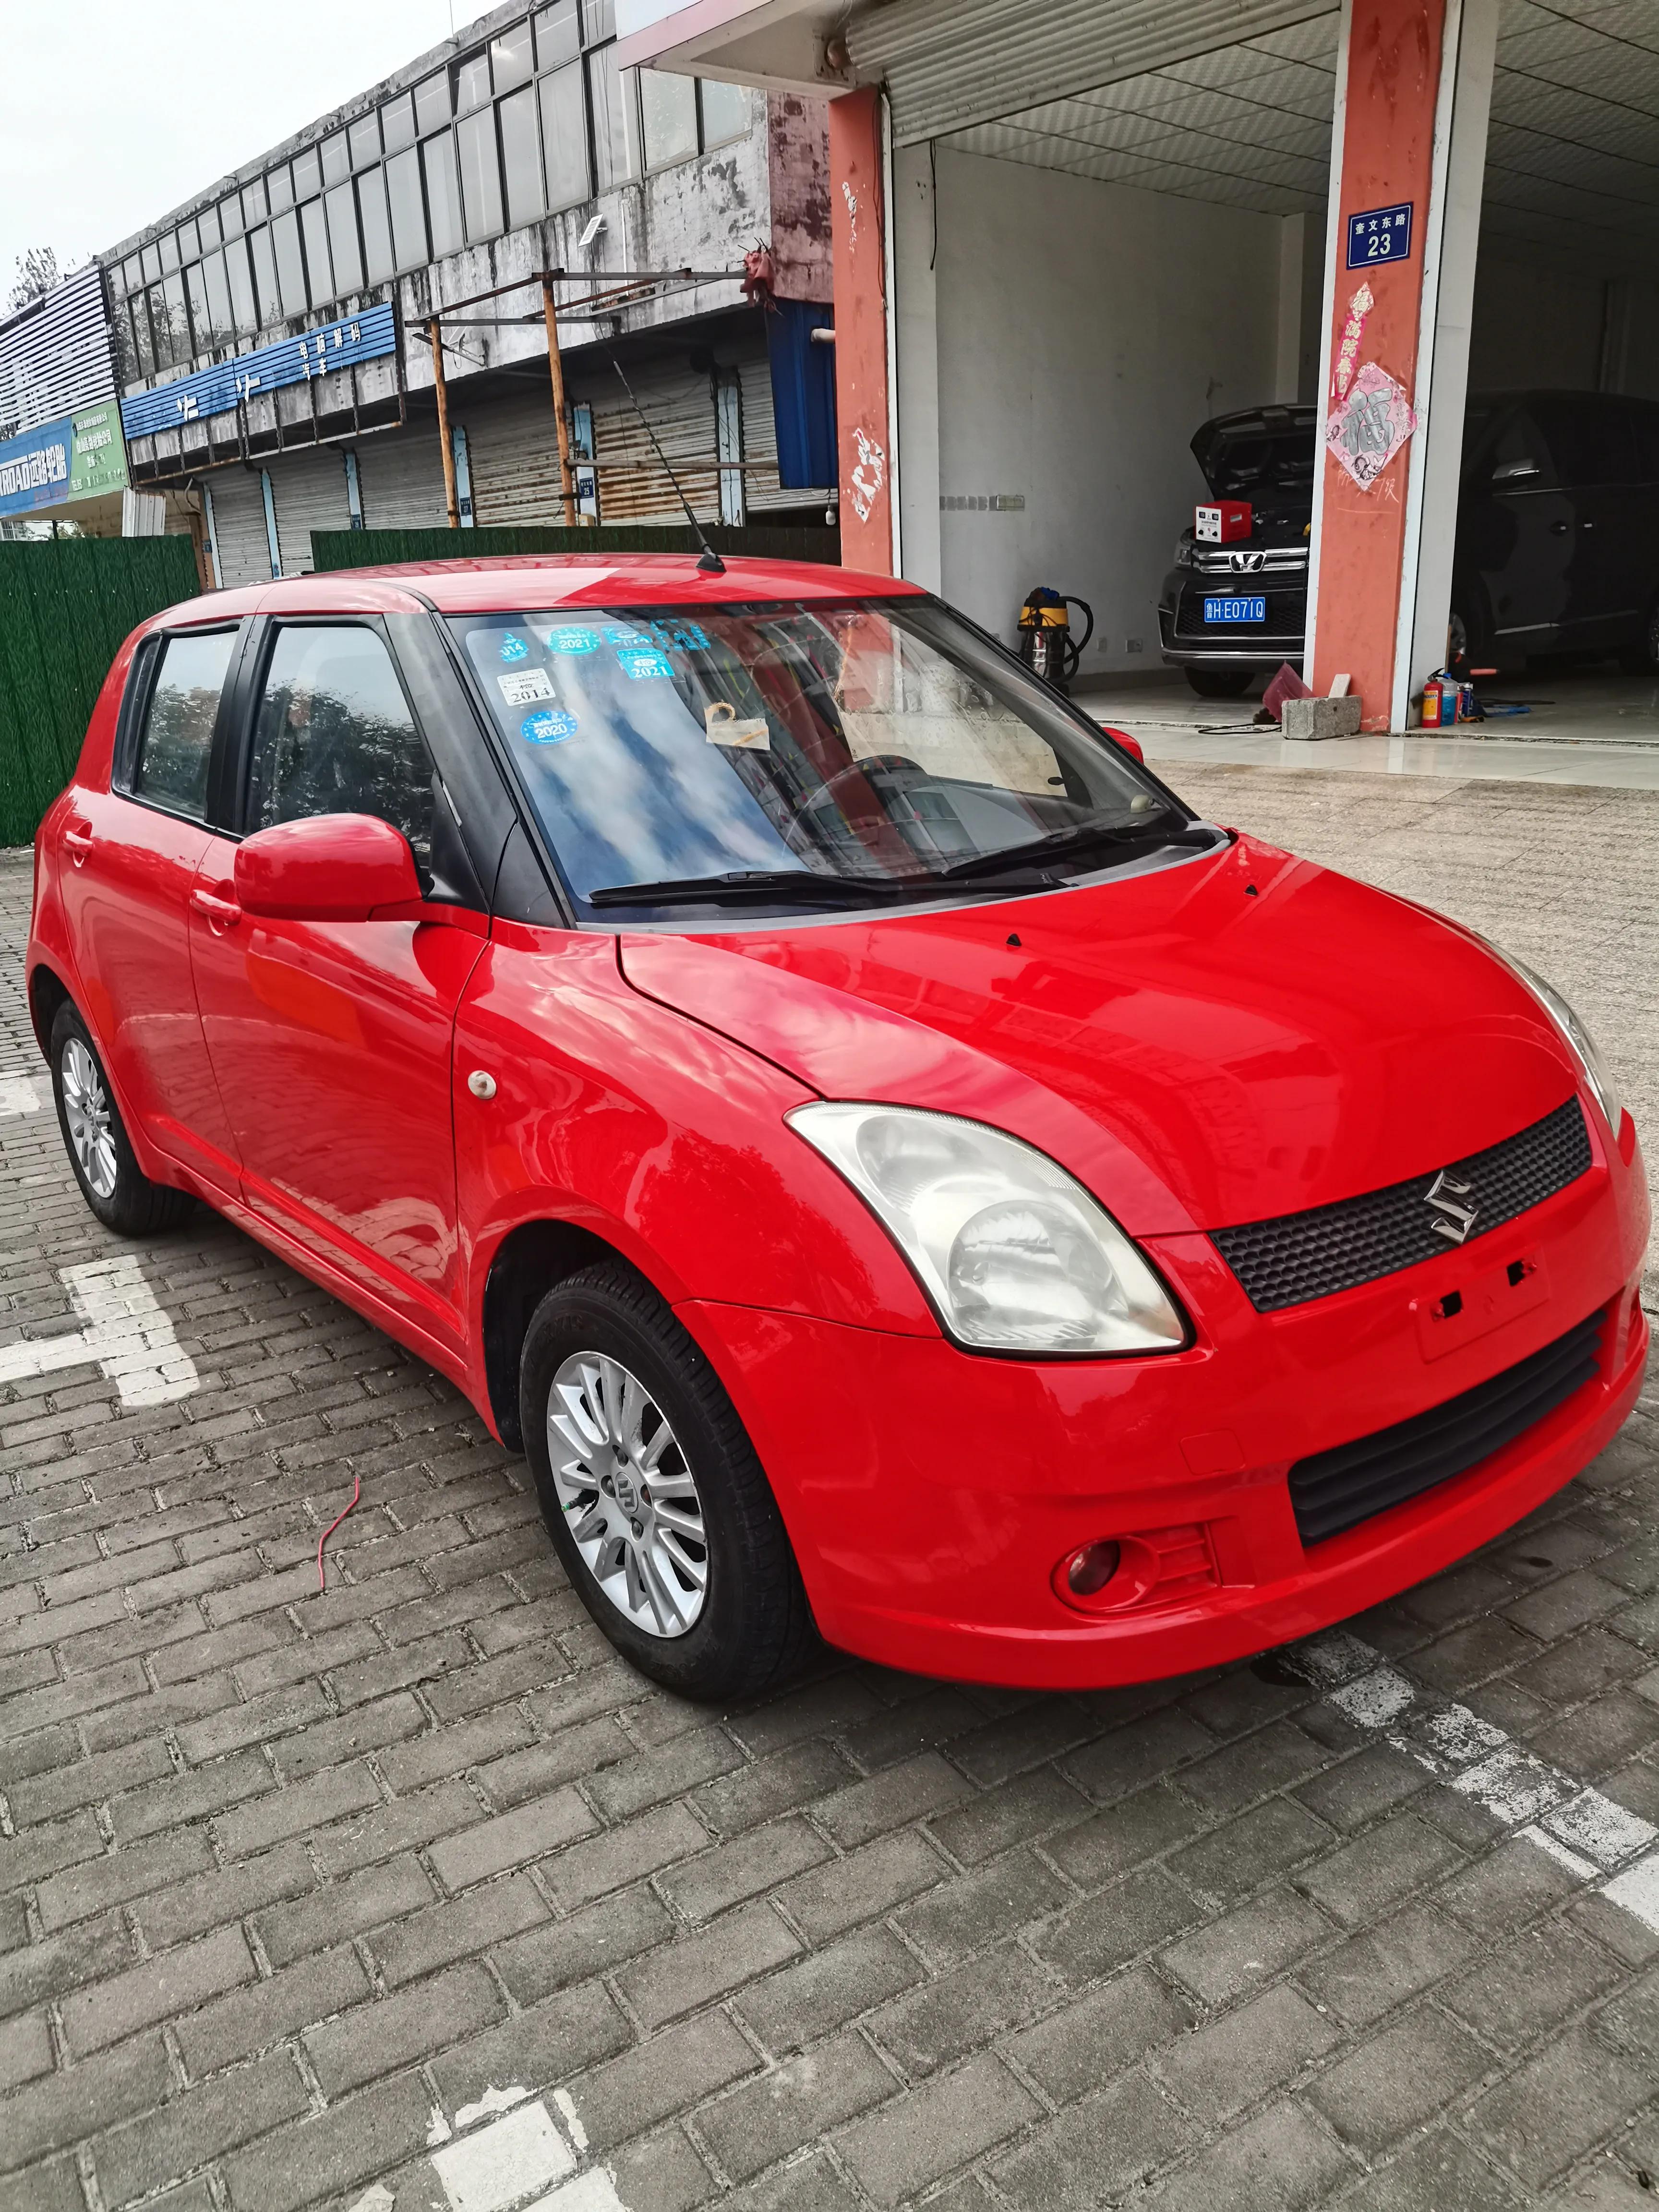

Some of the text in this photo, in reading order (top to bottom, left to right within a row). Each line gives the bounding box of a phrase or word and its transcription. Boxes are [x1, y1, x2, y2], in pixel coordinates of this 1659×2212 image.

[1355, 213, 1406, 235] 奎文东路
[1368, 233, 1391, 257] 23
[299, 321, 361, 360] 电脑解码
[302, 357, 327, 381] 汽车
[1340, 387, 1395, 456] 福
[559, 638, 590, 649] 2021
[631, 666, 669, 678] 2021
[511, 687, 551, 703] 2014
[537, 723, 567, 739] 2020
